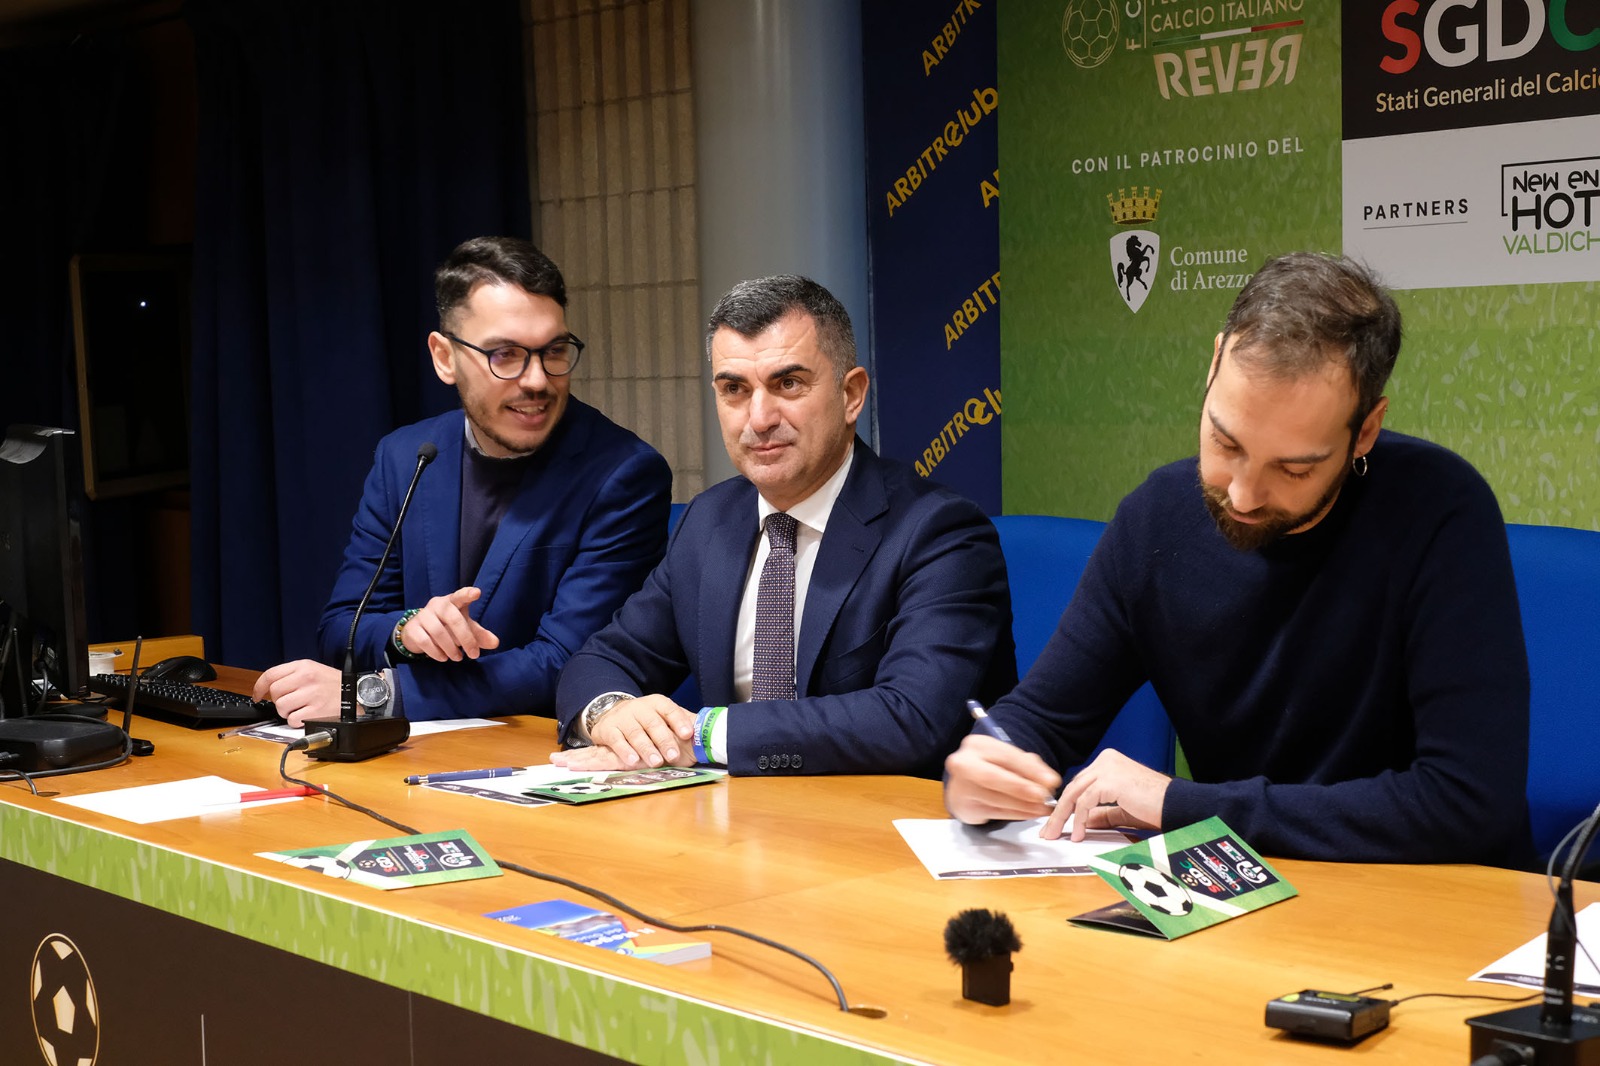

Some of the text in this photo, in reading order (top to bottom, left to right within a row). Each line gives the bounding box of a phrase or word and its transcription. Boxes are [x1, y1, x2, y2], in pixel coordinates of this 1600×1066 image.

[1151, 0, 1302, 33] CALCIO ITALIANO
[1379, 0, 1600, 74] SGDC
[1376, 67, 1600, 113] Stati Generali del Calci
[1072, 137, 1304, 174] CON IL PATROCINIO DEL
[1363, 198, 1468, 220] PARTNERS
[1512, 190, 1600, 231] HOT
[1170, 247, 1248, 266] Comune
[1170, 271, 1187, 291] di
